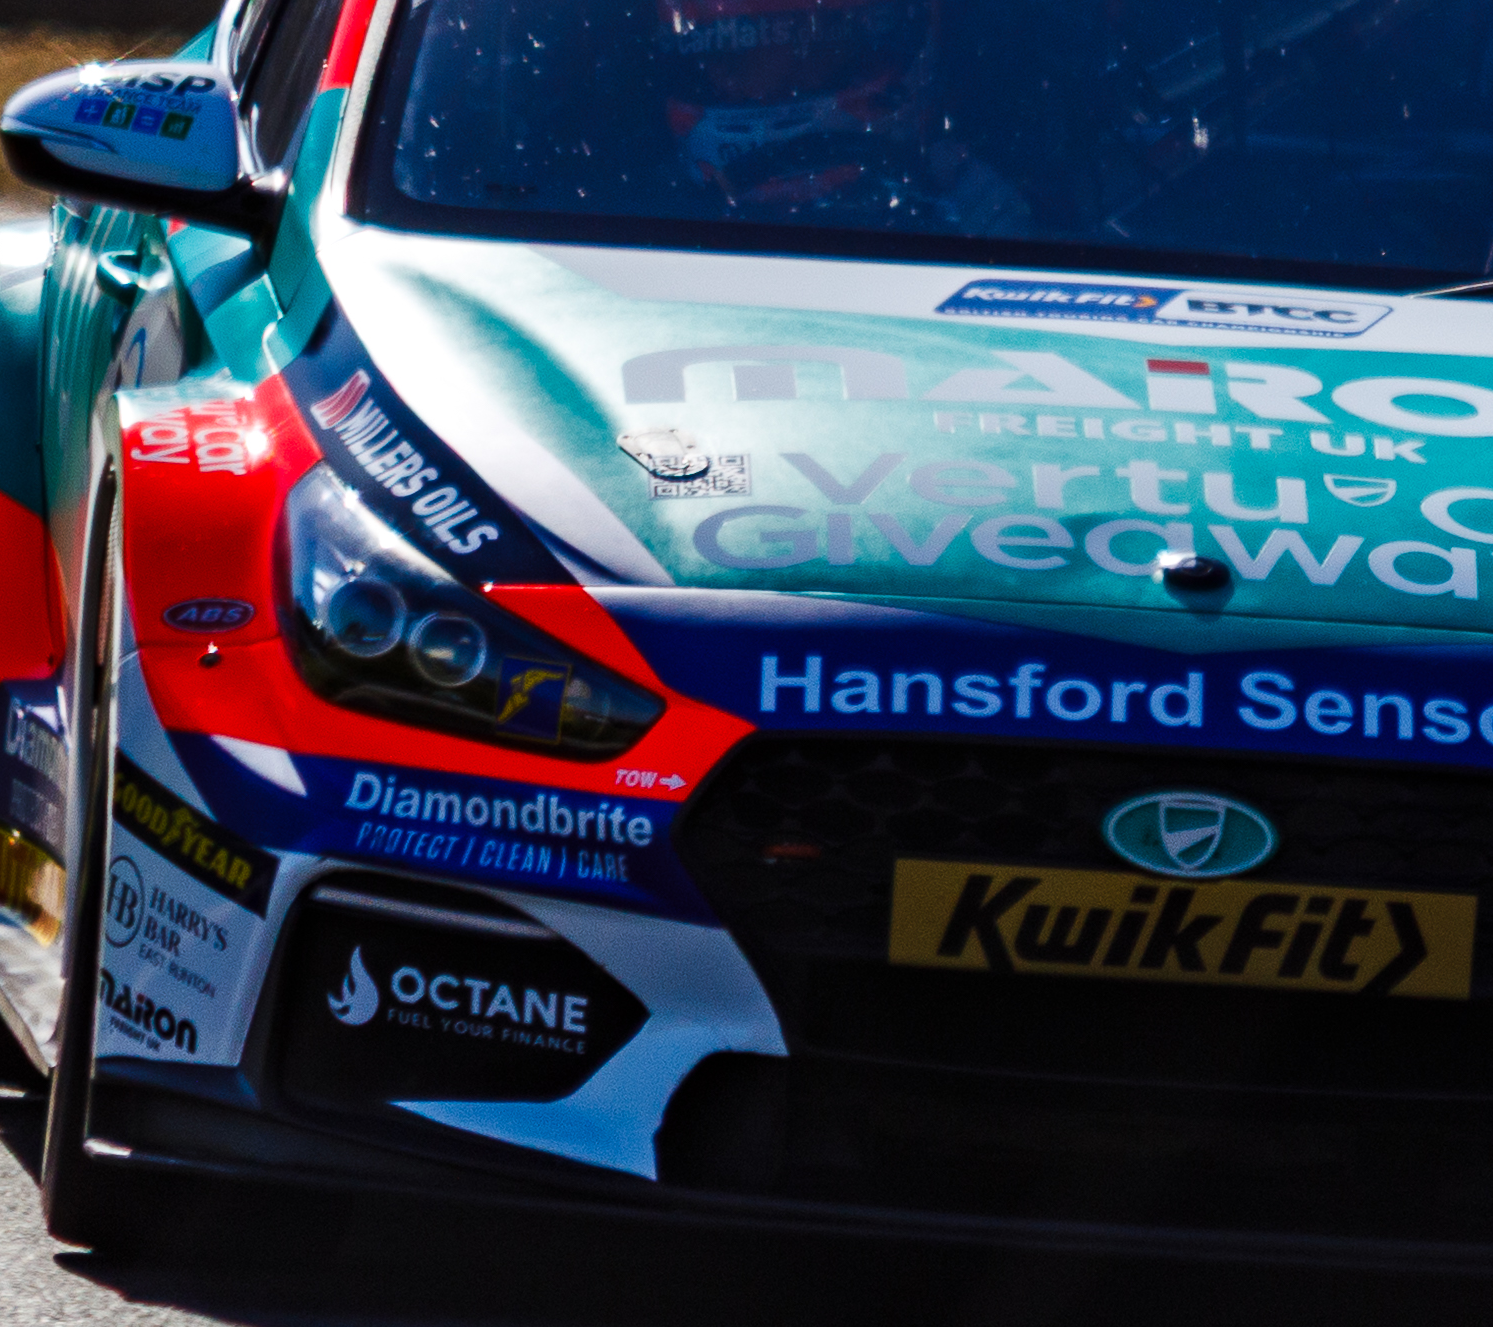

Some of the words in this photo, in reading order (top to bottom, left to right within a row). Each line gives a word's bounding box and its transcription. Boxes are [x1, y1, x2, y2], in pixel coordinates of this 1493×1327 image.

[1187, 299, 1359, 324] BTCC
[934, 410, 1283, 450] FREIGHT
[1309, 429, 1426, 464] UK
[335, 397, 426, 500] MILLERS
[411, 485, 500, 556] OILS
[781, 452, 1309, 524] Vertu
[759, 654, 1206, 728] Hansford
[345, 772, 654, 847] Diamondbrite
[616, 769, 659, 789] TOW
[356, 822, 460, 862] PROTECT
[480, 840, 552, 874] CLEAN
[577, 851, 630, 883] CARE
[144, 914, 191, 957] BAR
[149, 886, 239, 952] HARRY'S
[391, 966, 589, 1033] OCTANE
[387, 1008, 432, 1030] FUEL
[442, 1018, 494, 1041] YOUR
[502, 1028, 587, 1056] FINANCE
